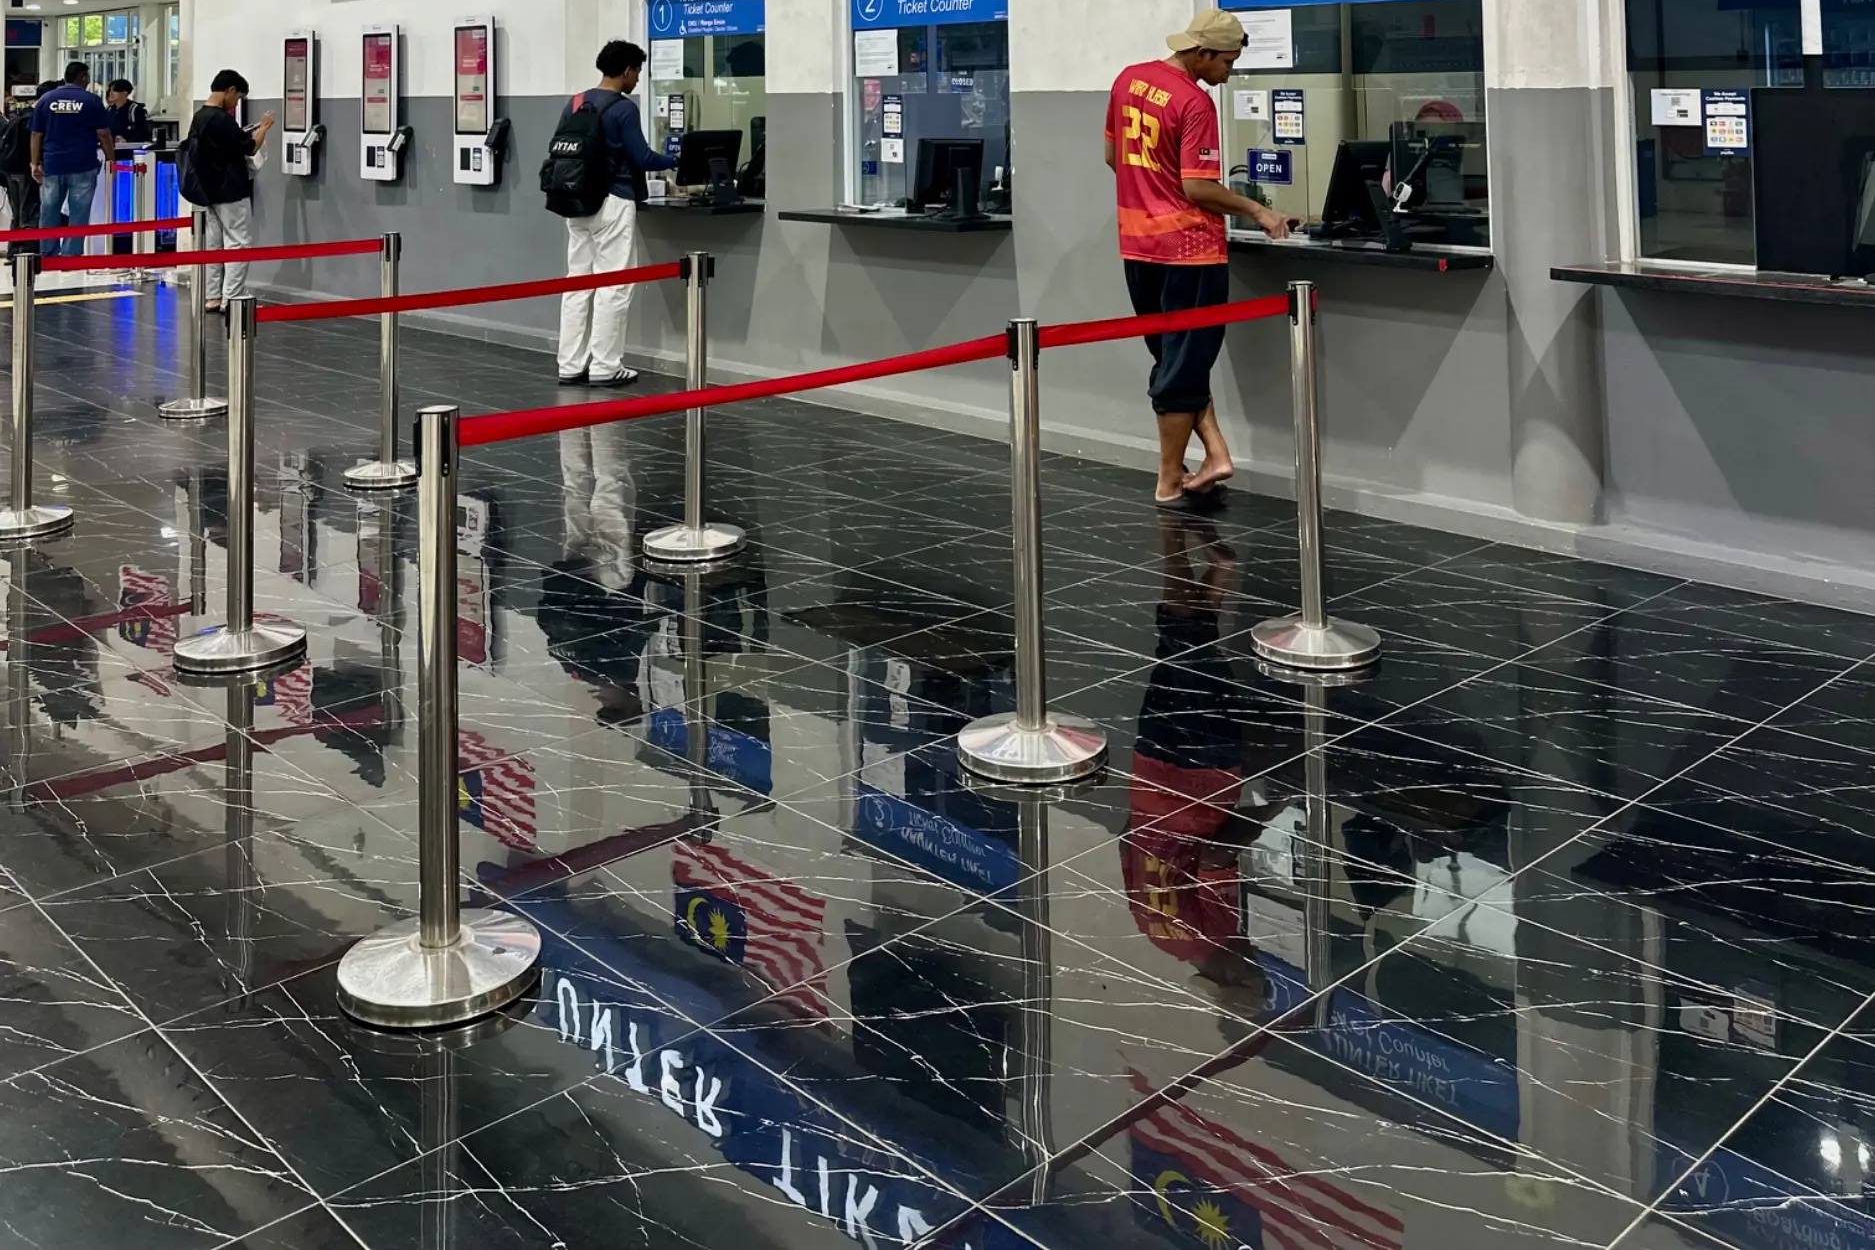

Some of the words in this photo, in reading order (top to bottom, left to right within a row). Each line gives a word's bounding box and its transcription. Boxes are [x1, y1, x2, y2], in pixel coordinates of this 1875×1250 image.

[683, 3, 704, 15] Ticket
[704, 2, 734, 14] Counter
[659, 5, 664, 24] 1
[951, 77, 974, 86] CLOSED
[50, 102, 83, 111] CREW
[1121, 105, 1161, 173] 22
[1255, 163, 1282, 173] OPEN
